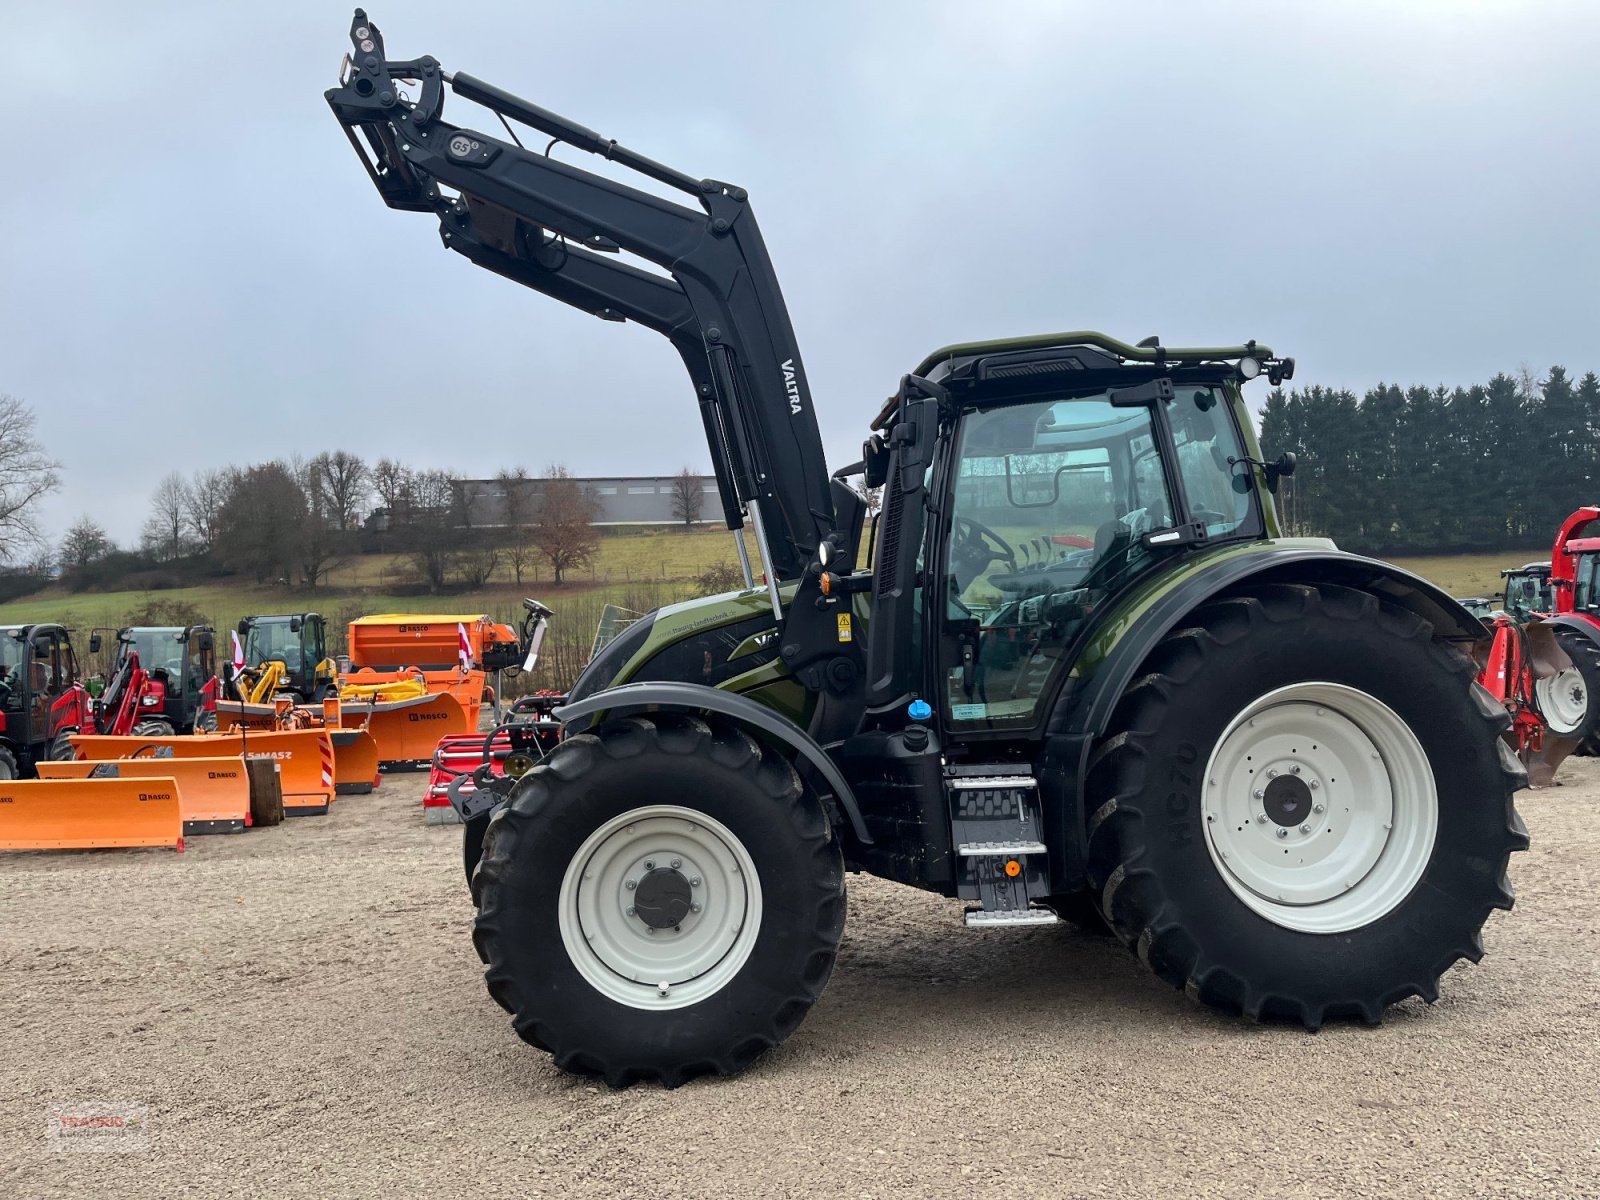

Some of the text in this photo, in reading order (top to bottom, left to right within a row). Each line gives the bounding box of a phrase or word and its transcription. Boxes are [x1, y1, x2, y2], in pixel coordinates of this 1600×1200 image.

[452, 140, 469, 152] G5
[781, 359, 802, 415] VALTRA
[420, 712, 448, 720] RASCO
